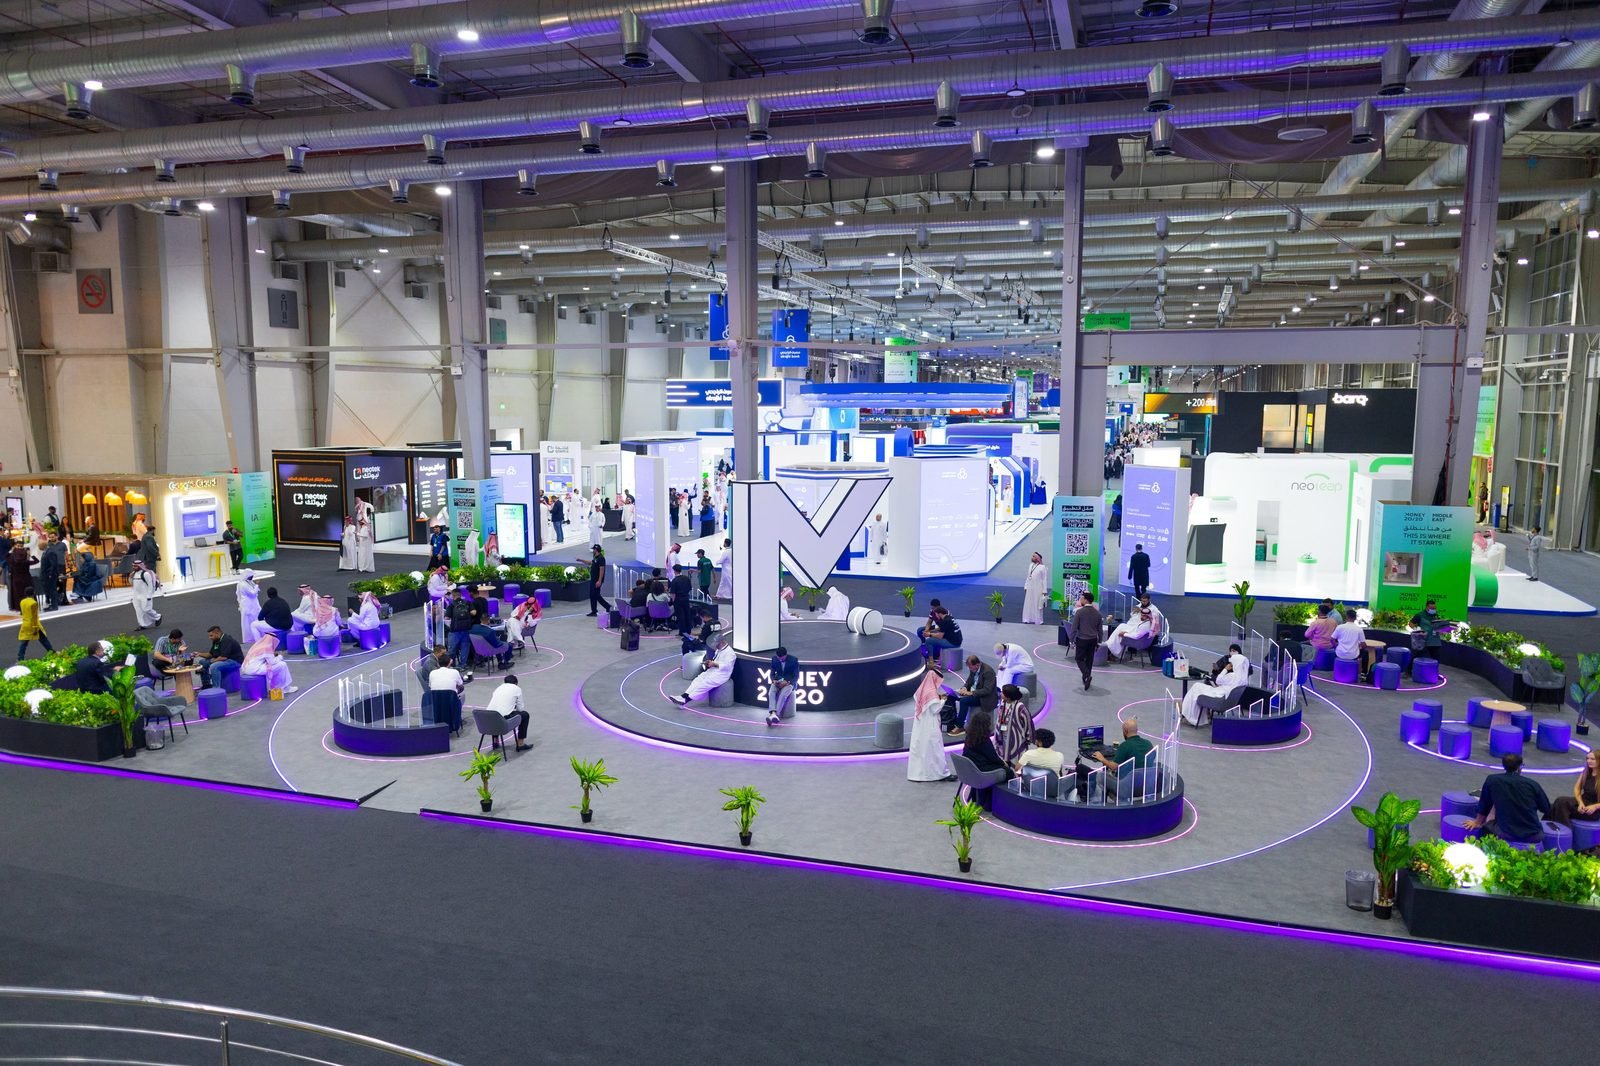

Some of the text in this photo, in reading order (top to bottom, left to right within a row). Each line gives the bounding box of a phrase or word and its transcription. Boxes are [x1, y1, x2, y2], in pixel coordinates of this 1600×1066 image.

[1332, 393, 1368, 406] barq
[168, 477, 217, 491] Google Cloud
